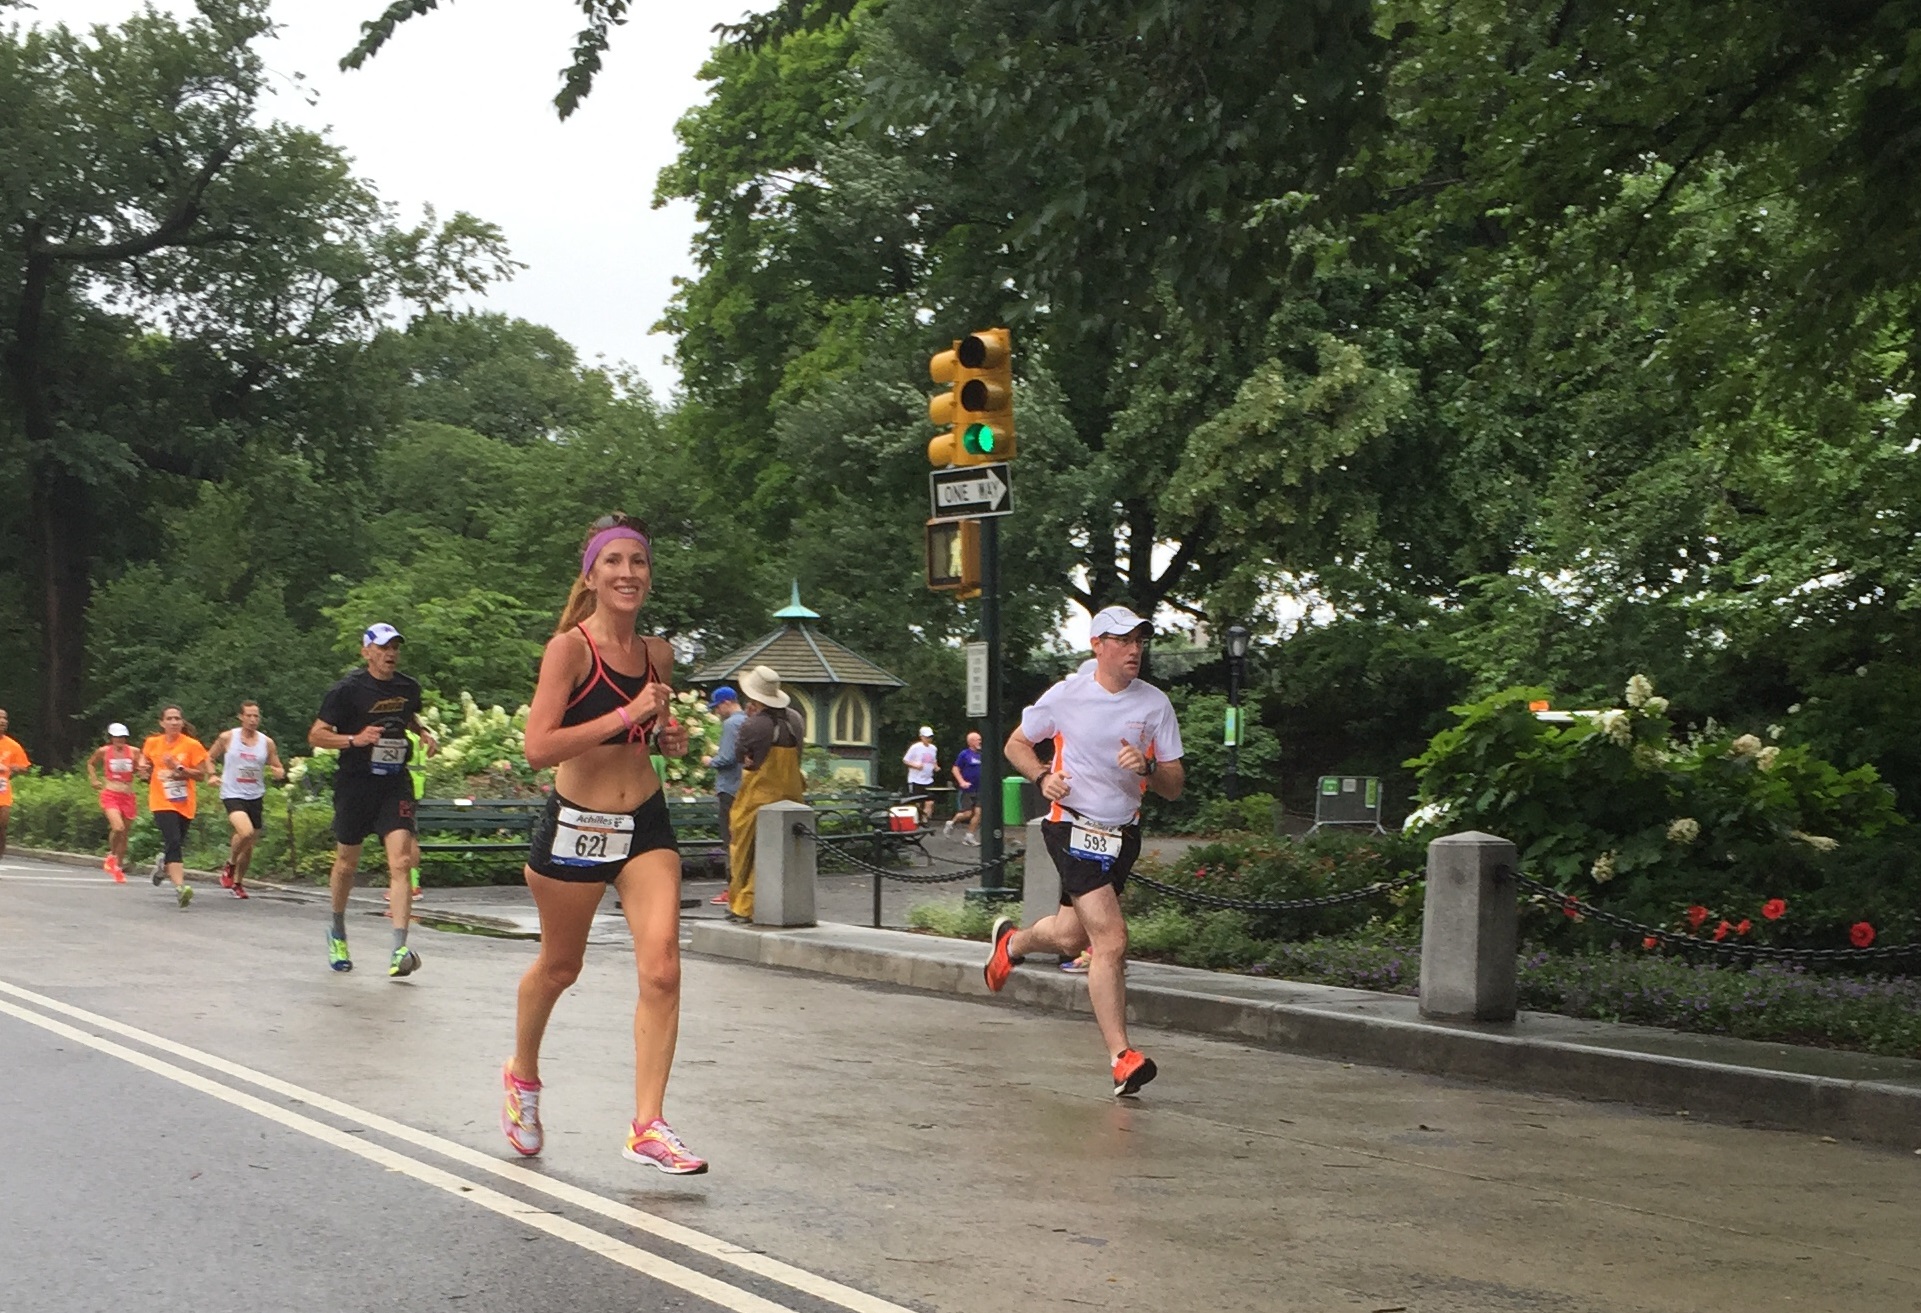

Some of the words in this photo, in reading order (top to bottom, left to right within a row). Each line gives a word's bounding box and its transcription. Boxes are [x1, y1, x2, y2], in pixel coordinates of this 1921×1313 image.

[945, 483, 969, 503] ONE
[978, 480, 1000, 500] WAY
[576, 814, 613, 826] Achilles
[575, 833, 608, 858] 621
[1083, 833, 1108, 853] 593
